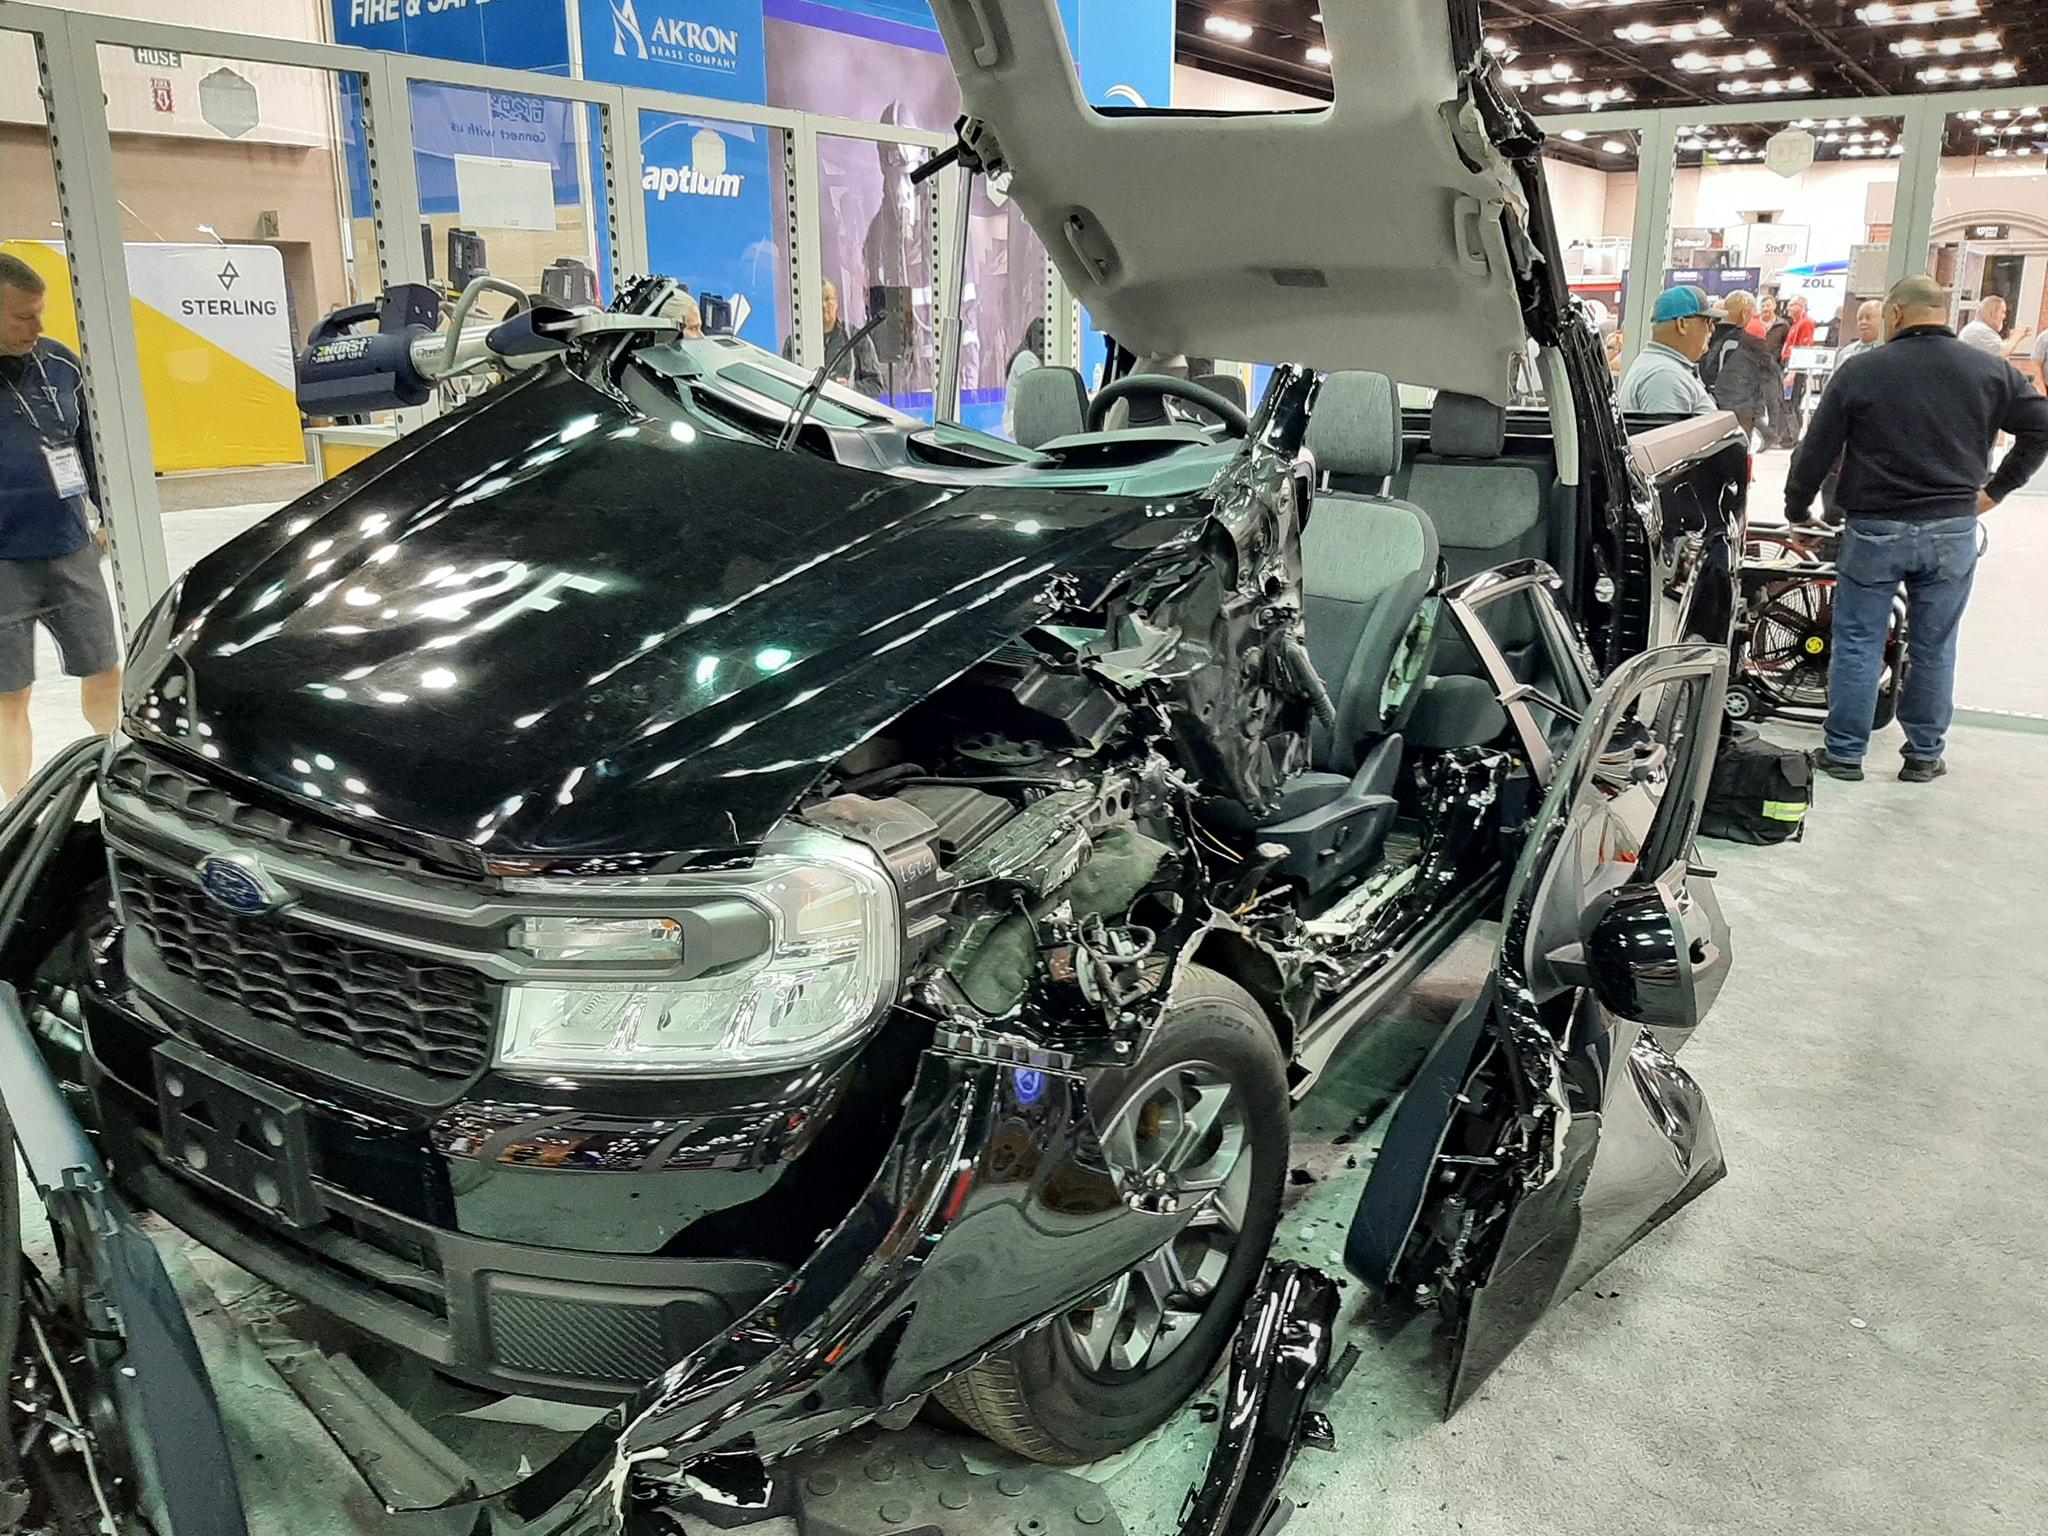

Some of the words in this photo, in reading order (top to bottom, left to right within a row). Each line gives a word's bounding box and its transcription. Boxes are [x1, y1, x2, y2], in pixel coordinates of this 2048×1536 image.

[351, 0, 401, 27] FIRE
[651, 16, 738, 56] AKRON
[651, 46, 683, 60] BRASS
[688, 52, 737, 69] COMPANY
[642, 165, 741, 201] aptium
[1802, 278, 1835, 289] ZOLL
[181, 299, 277, 315] STERLING
[324, 338, 368, 355] HURST
